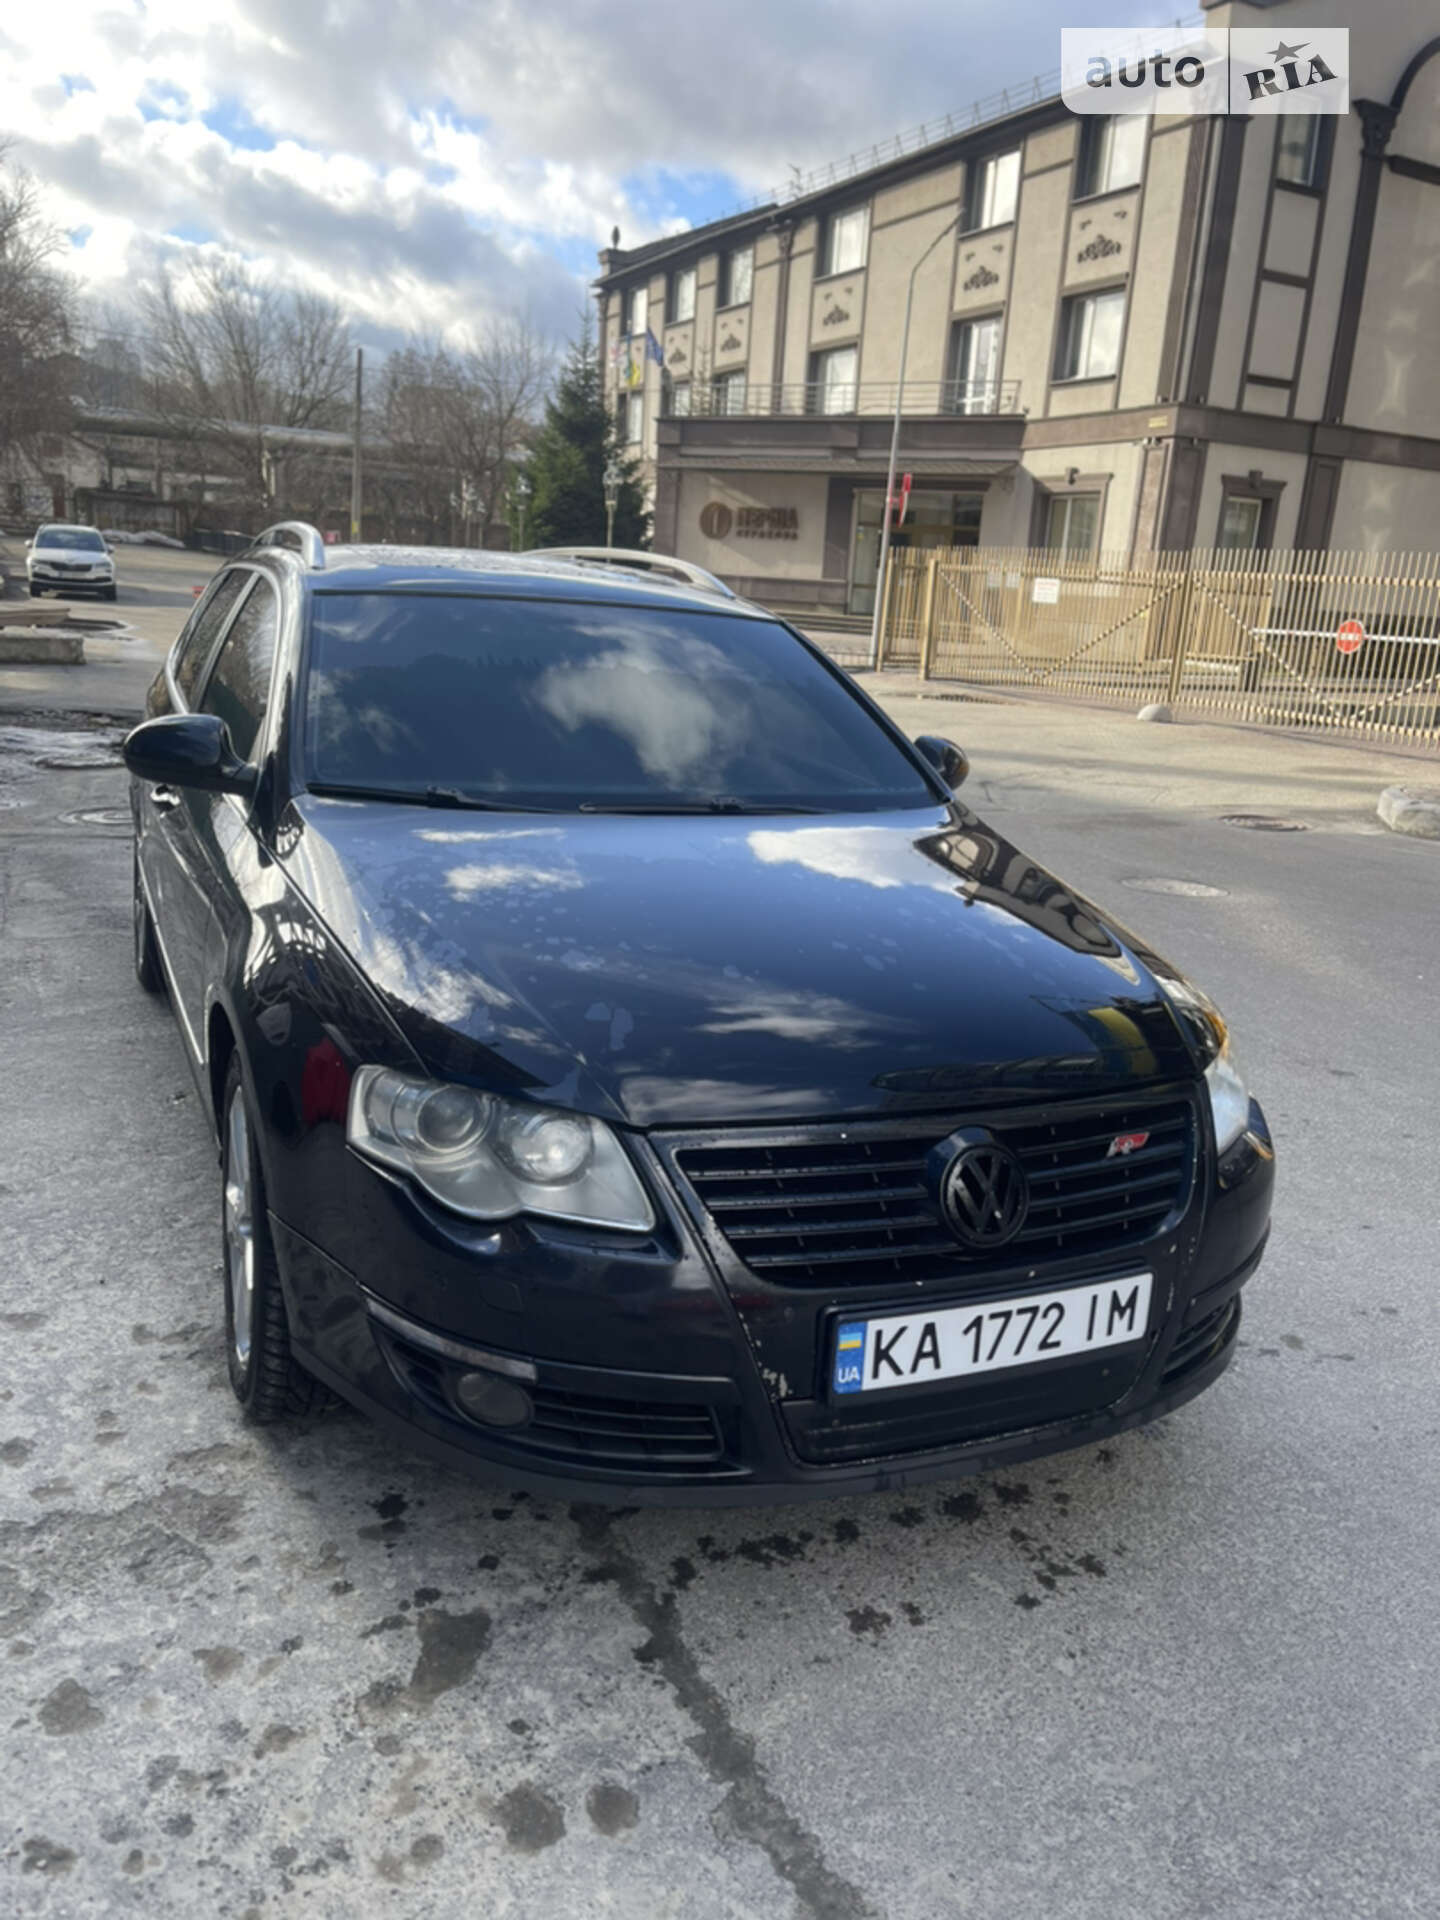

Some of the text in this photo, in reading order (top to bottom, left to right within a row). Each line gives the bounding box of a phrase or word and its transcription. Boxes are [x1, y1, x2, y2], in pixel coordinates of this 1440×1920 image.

[872, 1285, 1139, 1380] KA 1772 IM
[838, 1367, 860, 1384] UA
